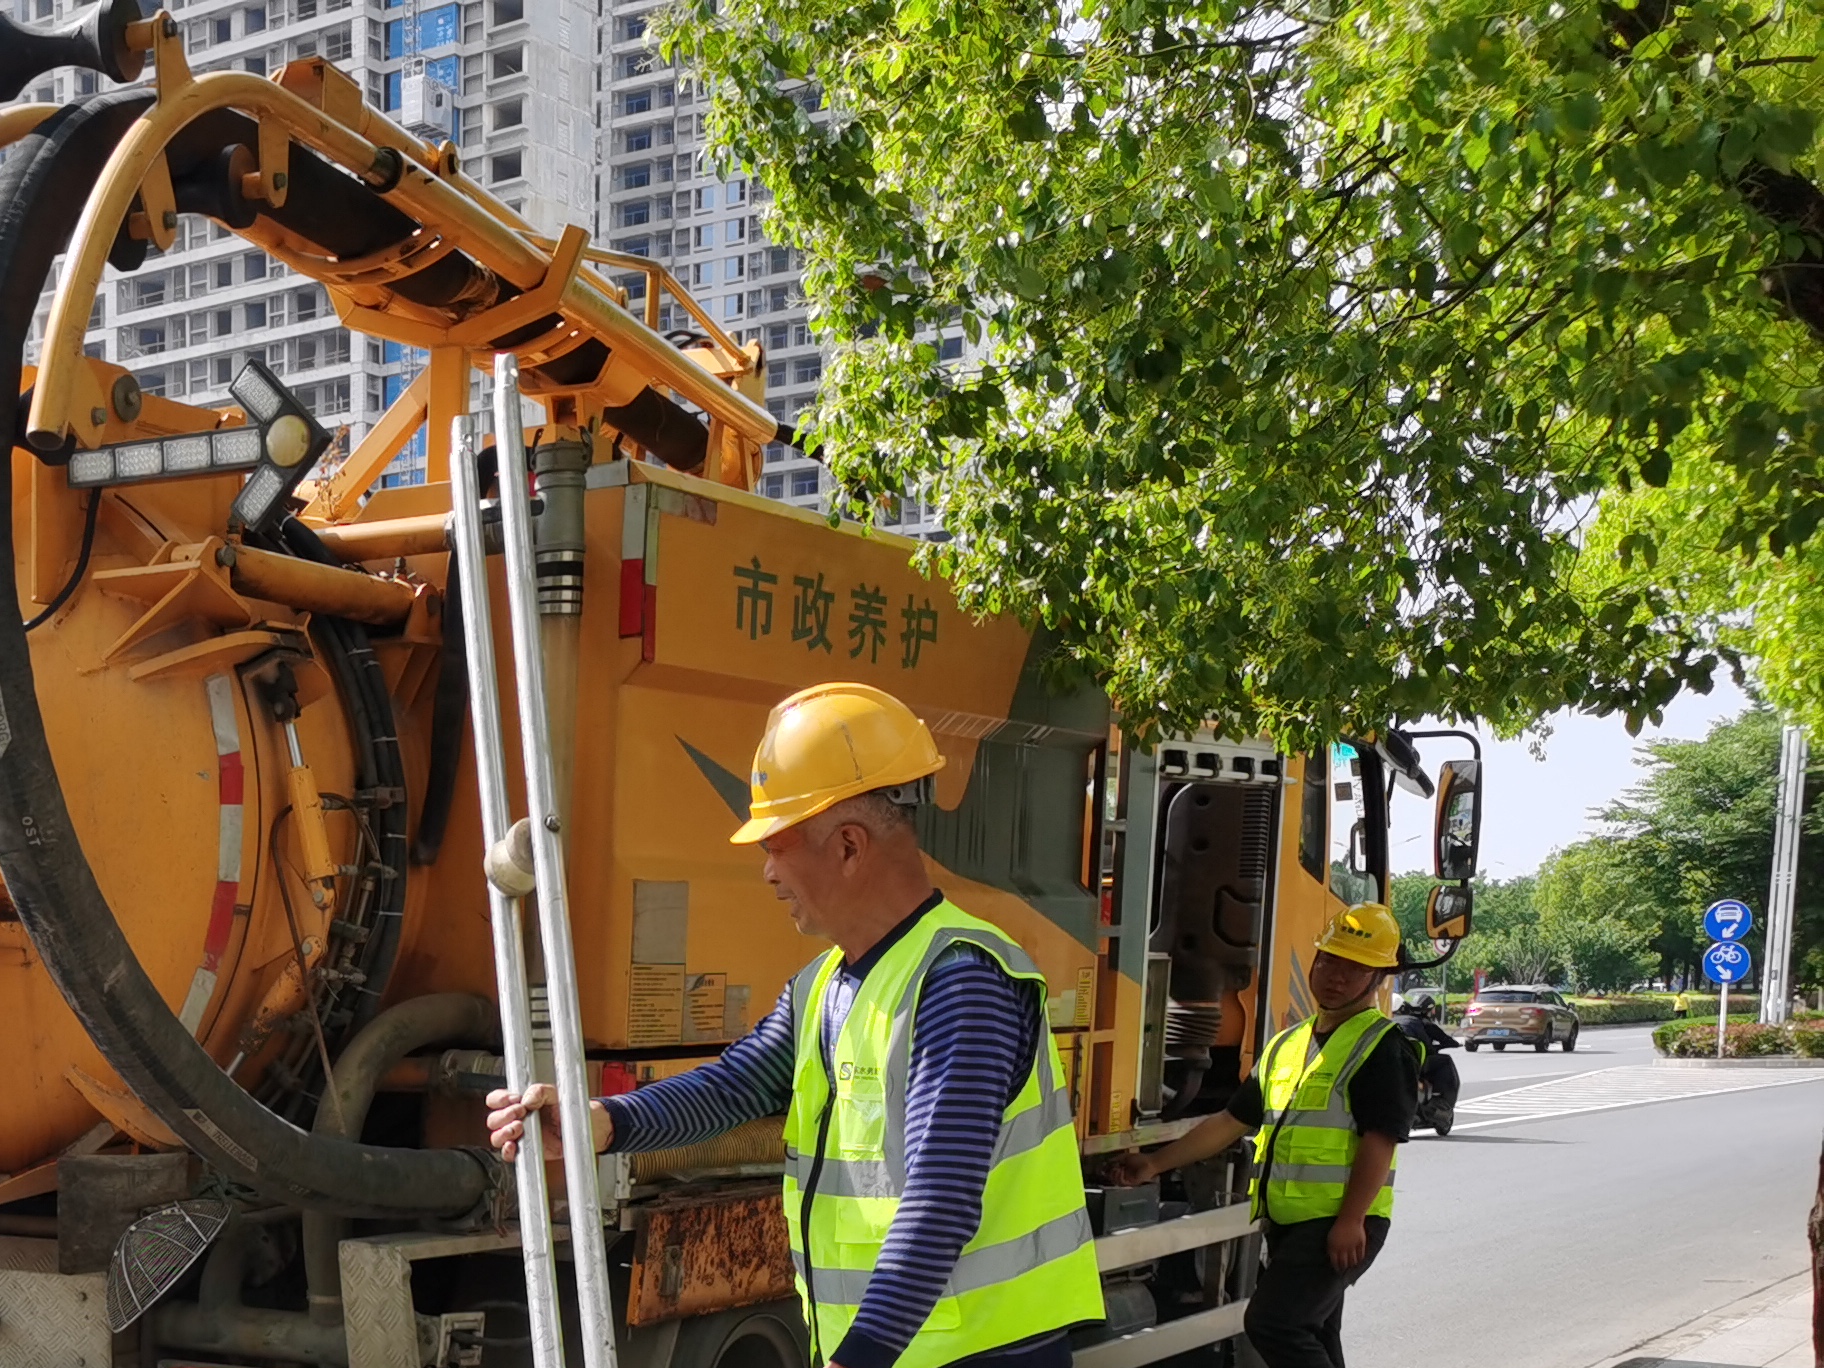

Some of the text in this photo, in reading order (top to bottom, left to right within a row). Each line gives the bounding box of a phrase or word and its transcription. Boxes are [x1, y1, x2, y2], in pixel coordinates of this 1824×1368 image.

[733, 555, 938, 669] 市政养护
[21, 816, 42, 846] OST
